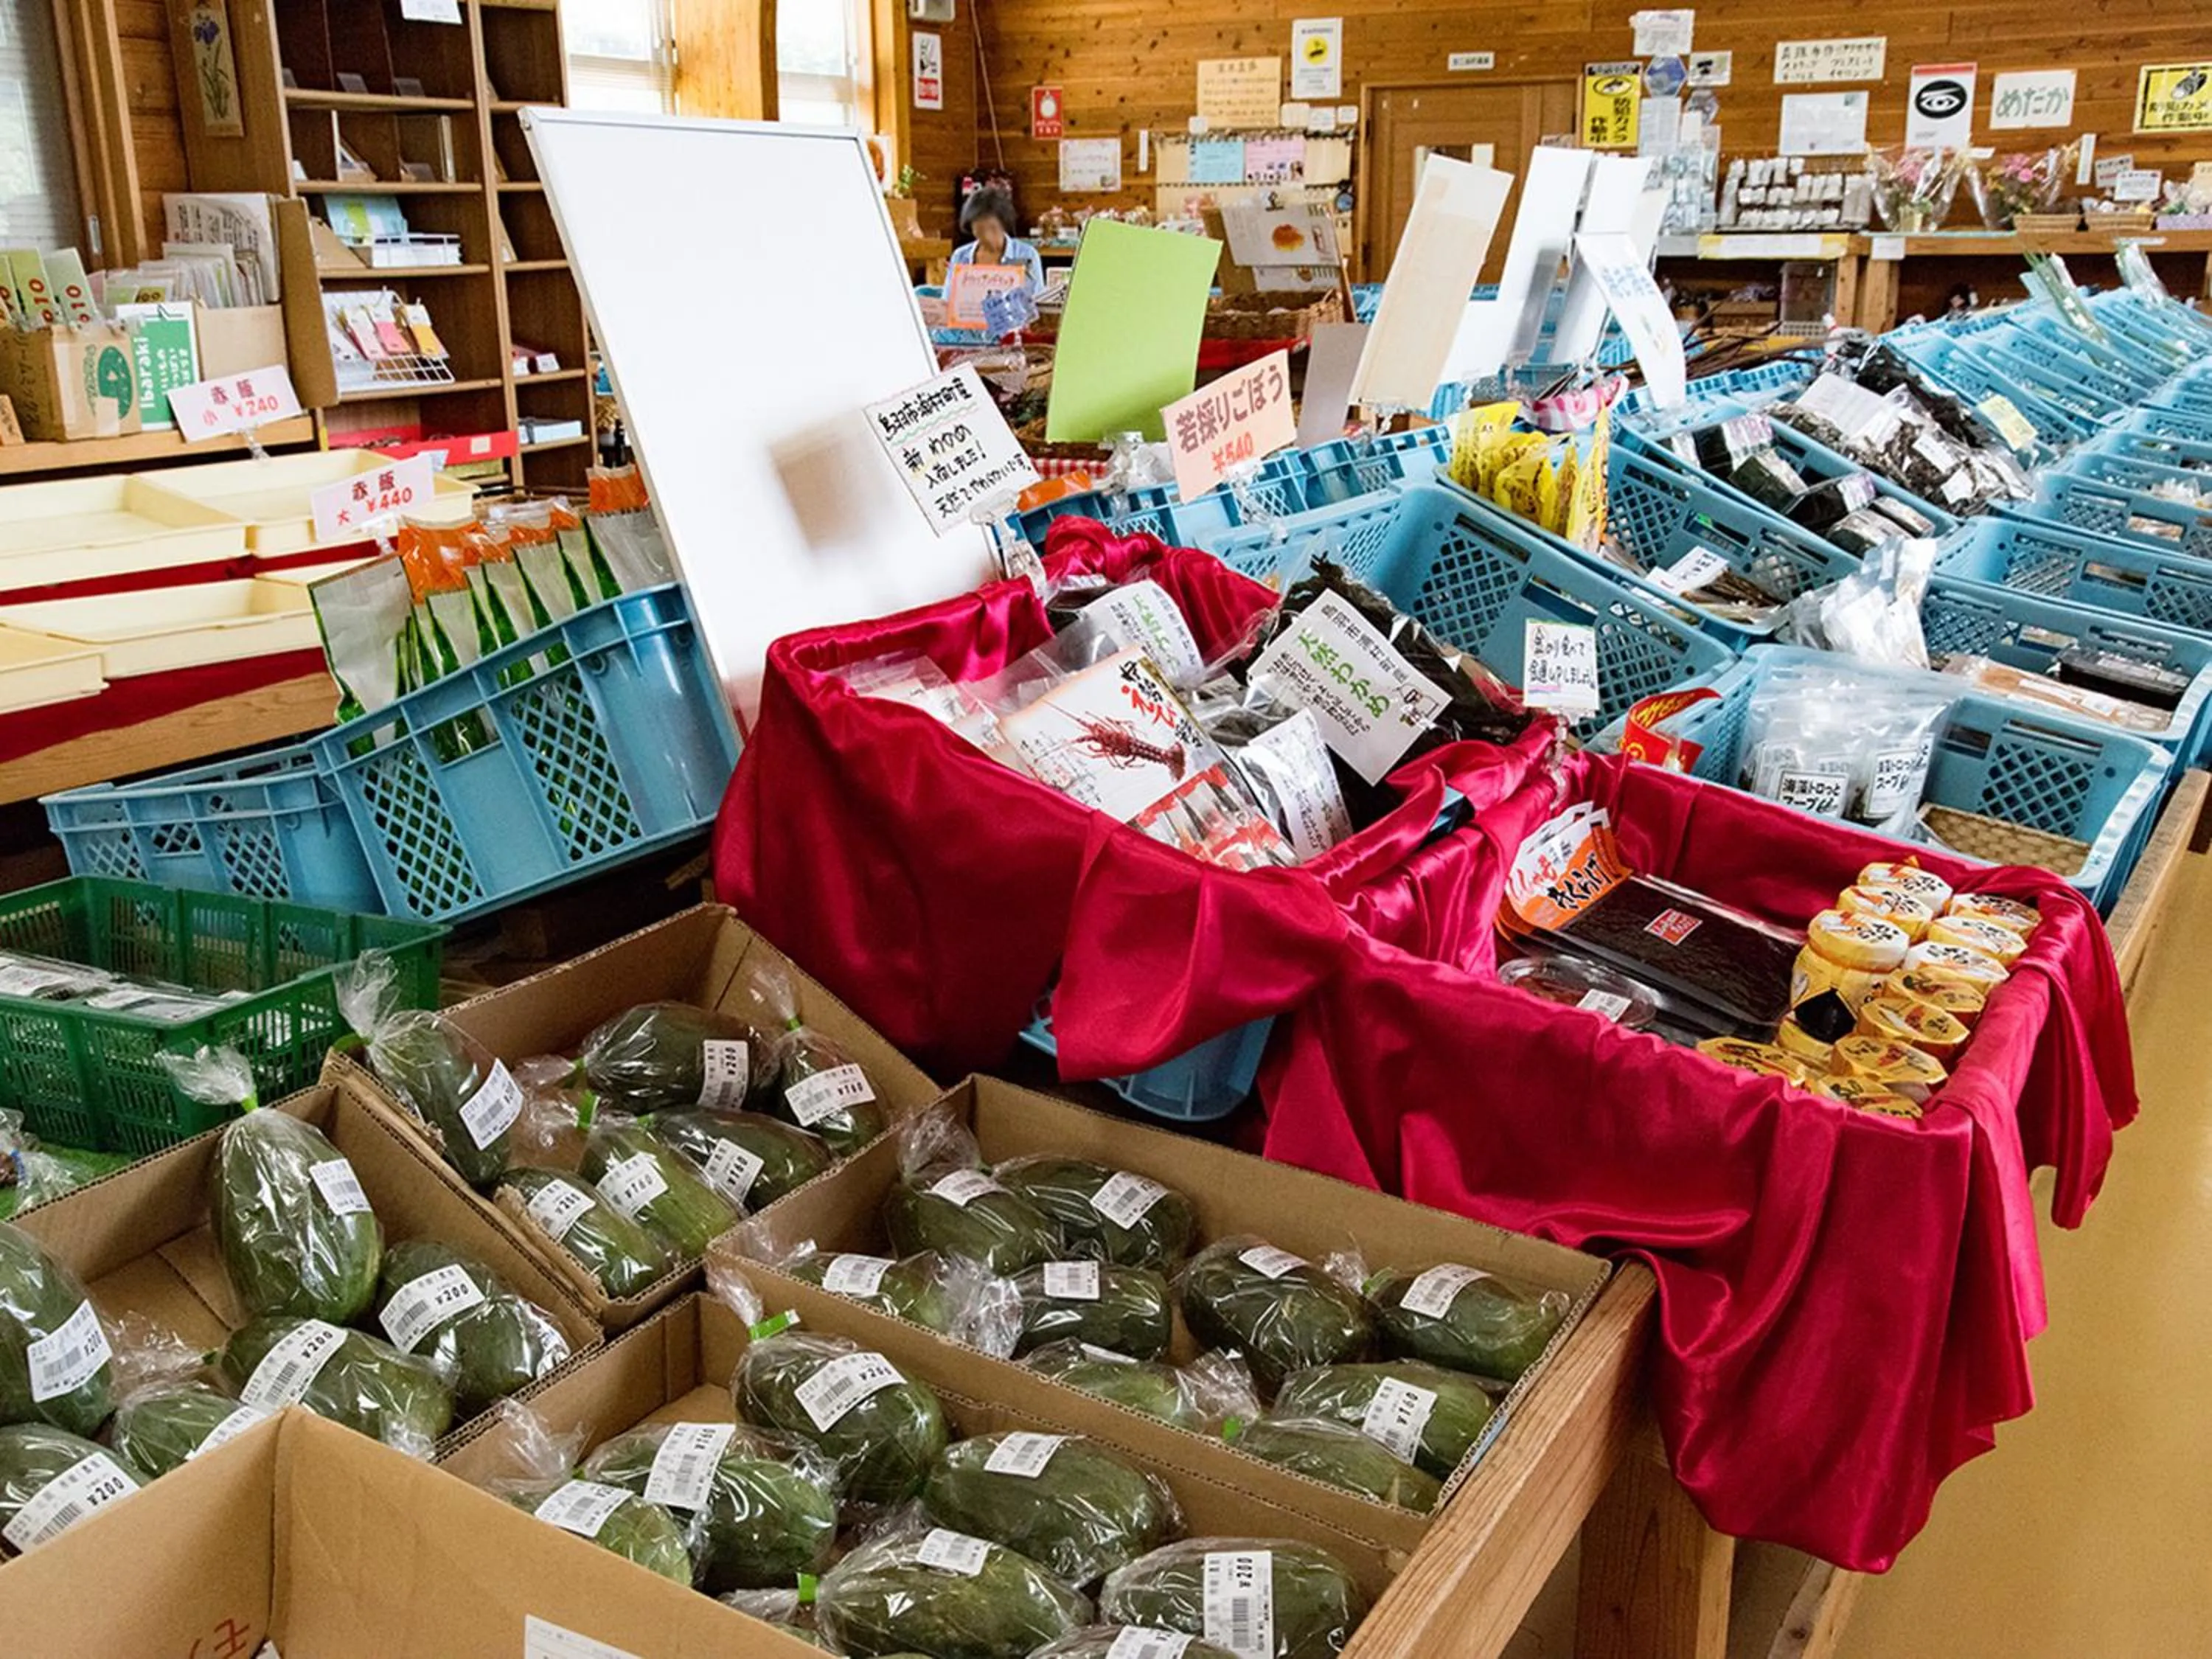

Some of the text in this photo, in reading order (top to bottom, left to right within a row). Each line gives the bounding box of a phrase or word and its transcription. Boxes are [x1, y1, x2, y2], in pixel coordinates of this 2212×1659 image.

[1996, 86, 2068, 118] めだか
[1176, 364, 1283, 453] 若採りごぼう
[1293, 625, 1393, 720] 天然わかめ
[1546, 852, 1603, 911] きくらげ
[434, 1281, 470, 1307] ¥200
[299, 1326, 334, 1361] ¥200
[85, 1473, 125, 1509] ¥200
[1236, 1557, 1253, 1587] ¥200
